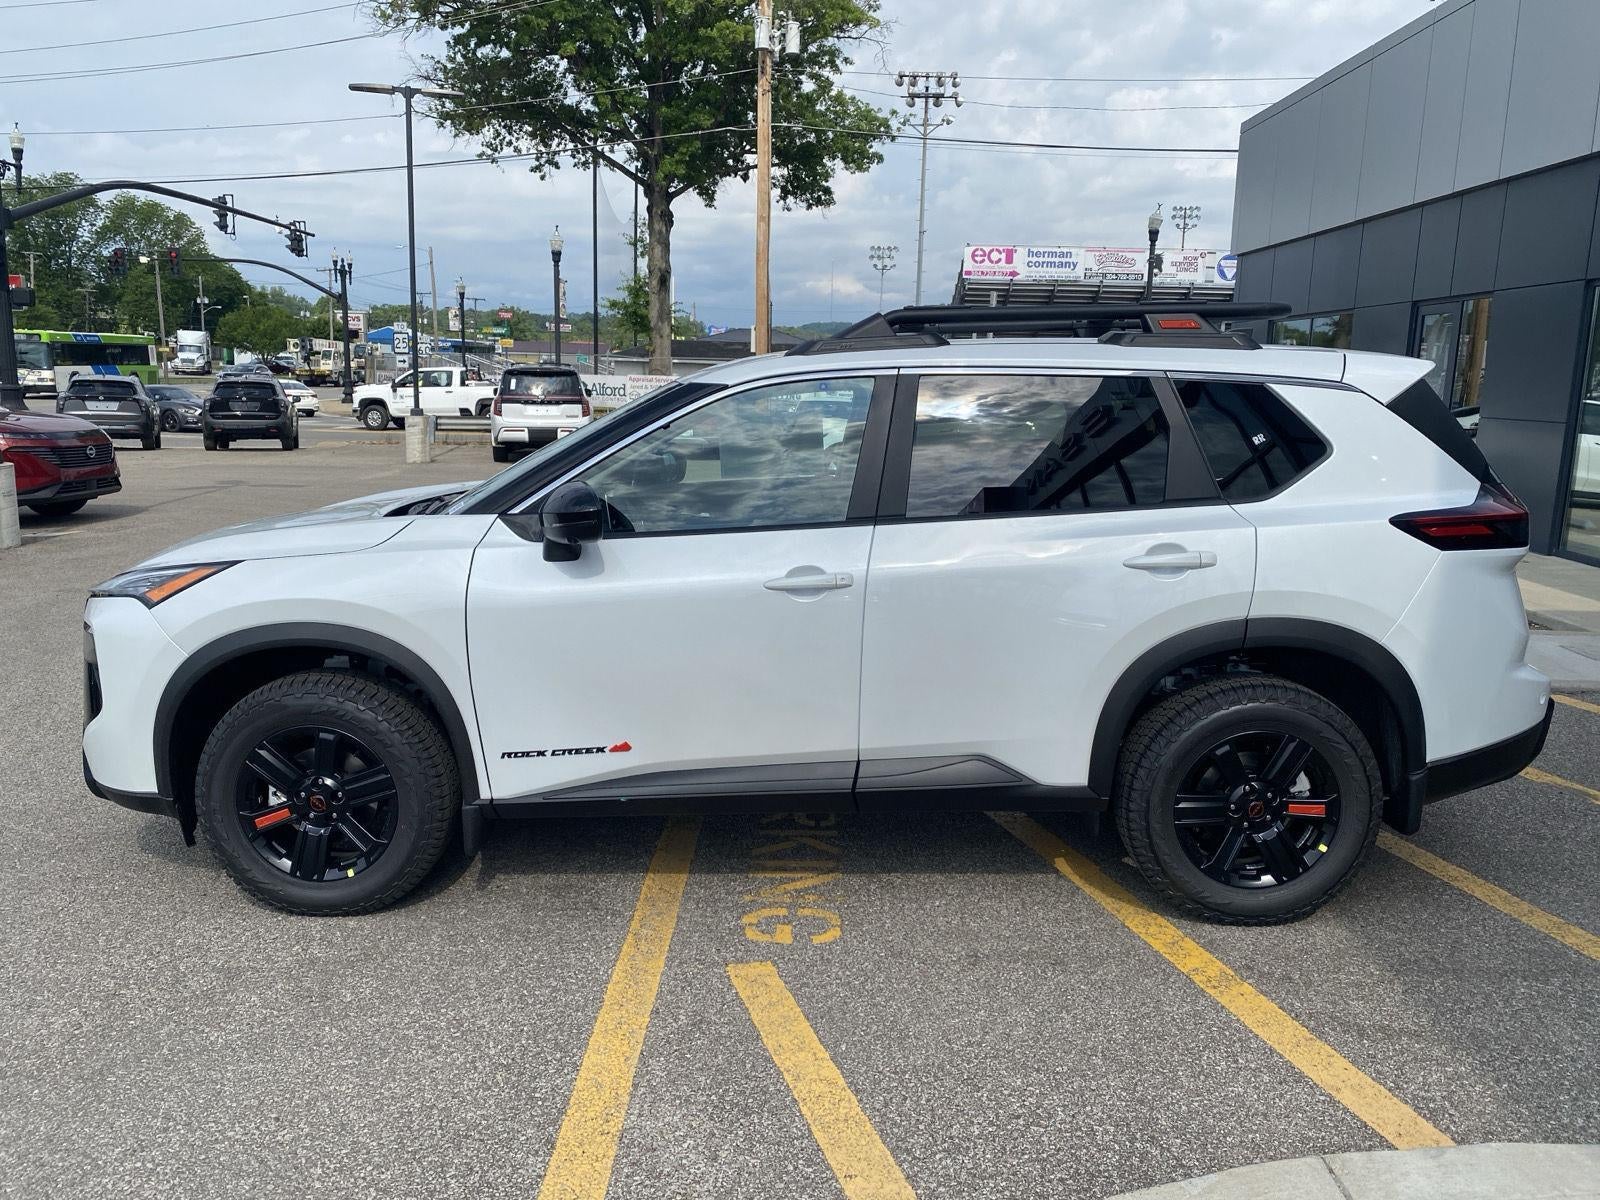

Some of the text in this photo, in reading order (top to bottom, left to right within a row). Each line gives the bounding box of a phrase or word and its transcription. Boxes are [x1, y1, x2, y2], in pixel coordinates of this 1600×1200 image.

[1027, 248, 1073, 259] herman
[1026, 260, 1079, 270] cormany
[394, 337, 408, 349] 25
[591, 383, 627, 397] Alford
[500, 746, 608, 759] ROCK CREEK
